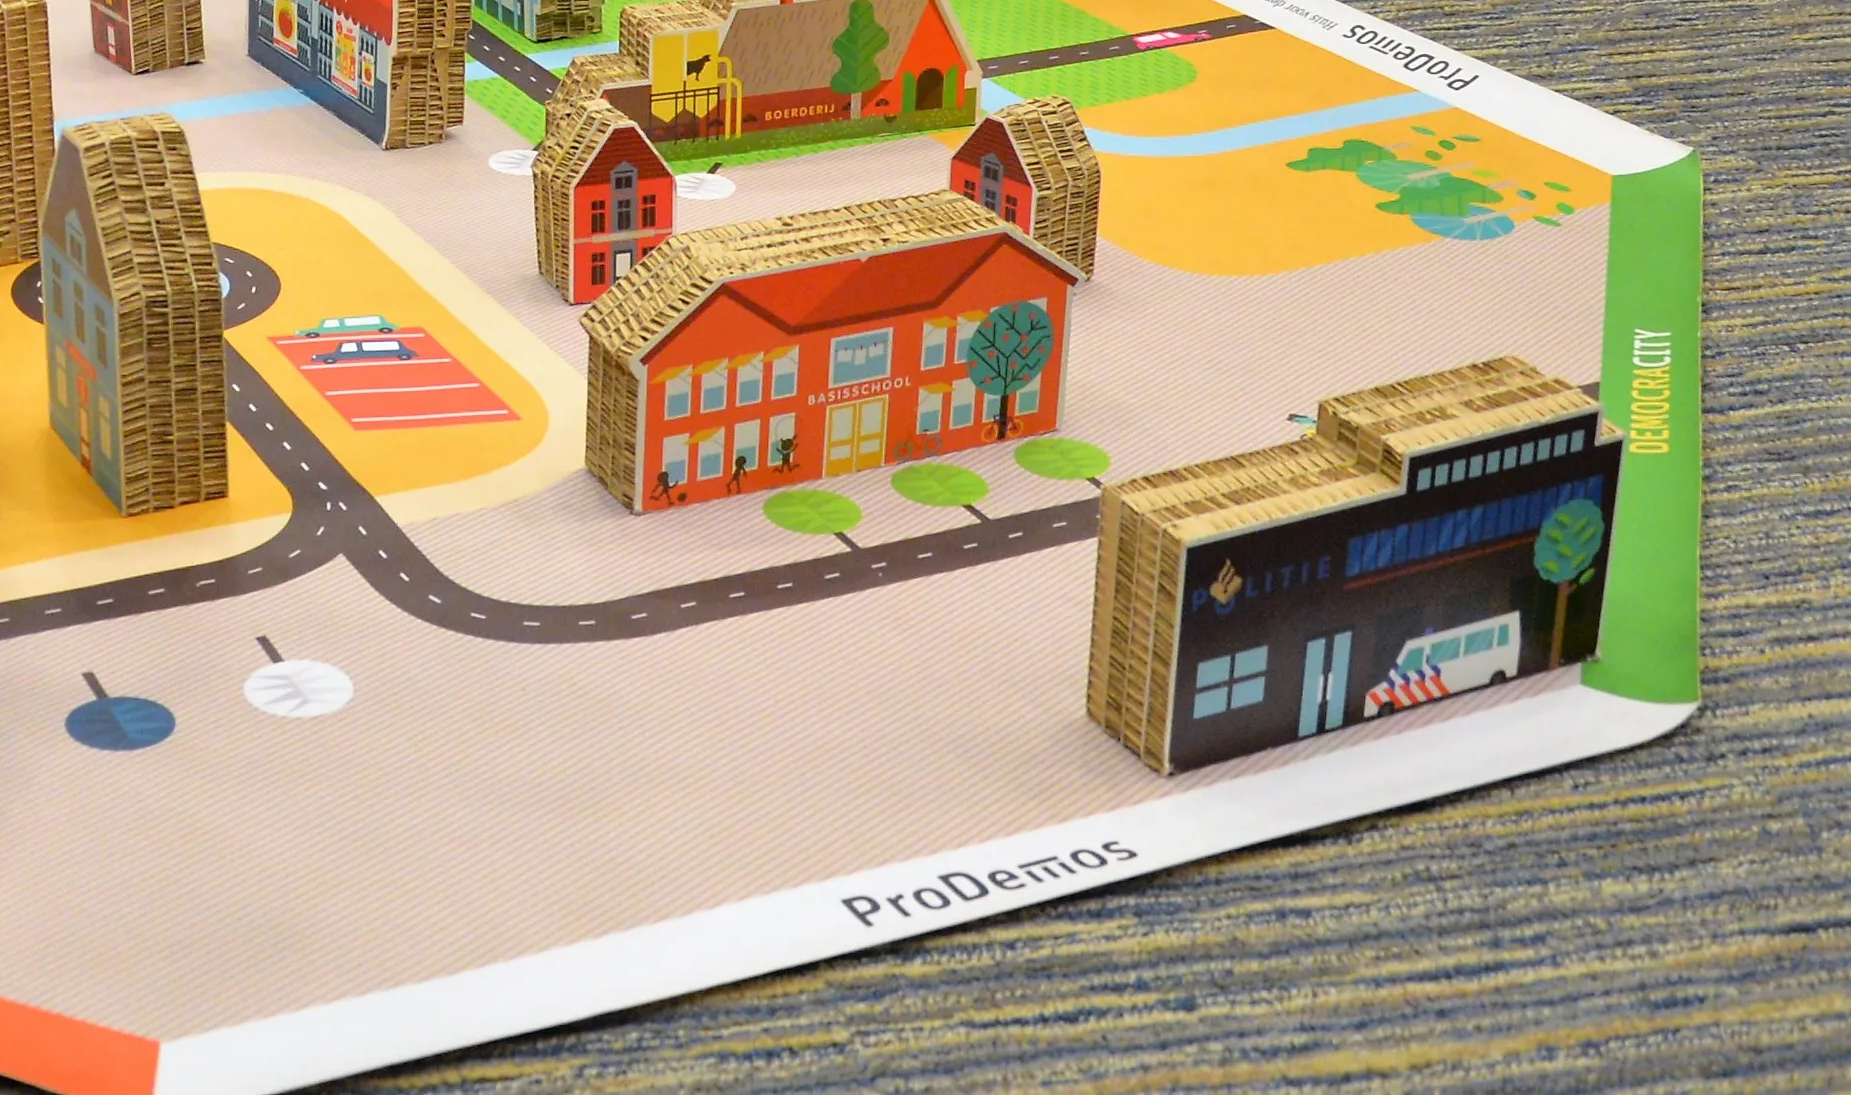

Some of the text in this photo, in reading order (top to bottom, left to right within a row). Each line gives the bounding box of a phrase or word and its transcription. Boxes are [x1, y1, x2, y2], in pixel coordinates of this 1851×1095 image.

[1285, 3, 1310, 18] voor
[1310, 14, 1339, 31] Huis
[1341, 24, 1479, 91] ProDemos
[764, 103, 836, 121] BOERDERIJ
[808, 376, 911, 406] BASISSCHOOL
[1628, 328, 1672, 454] DEMOCRACITY
[841, 840, 1138, 927] ProDemos
